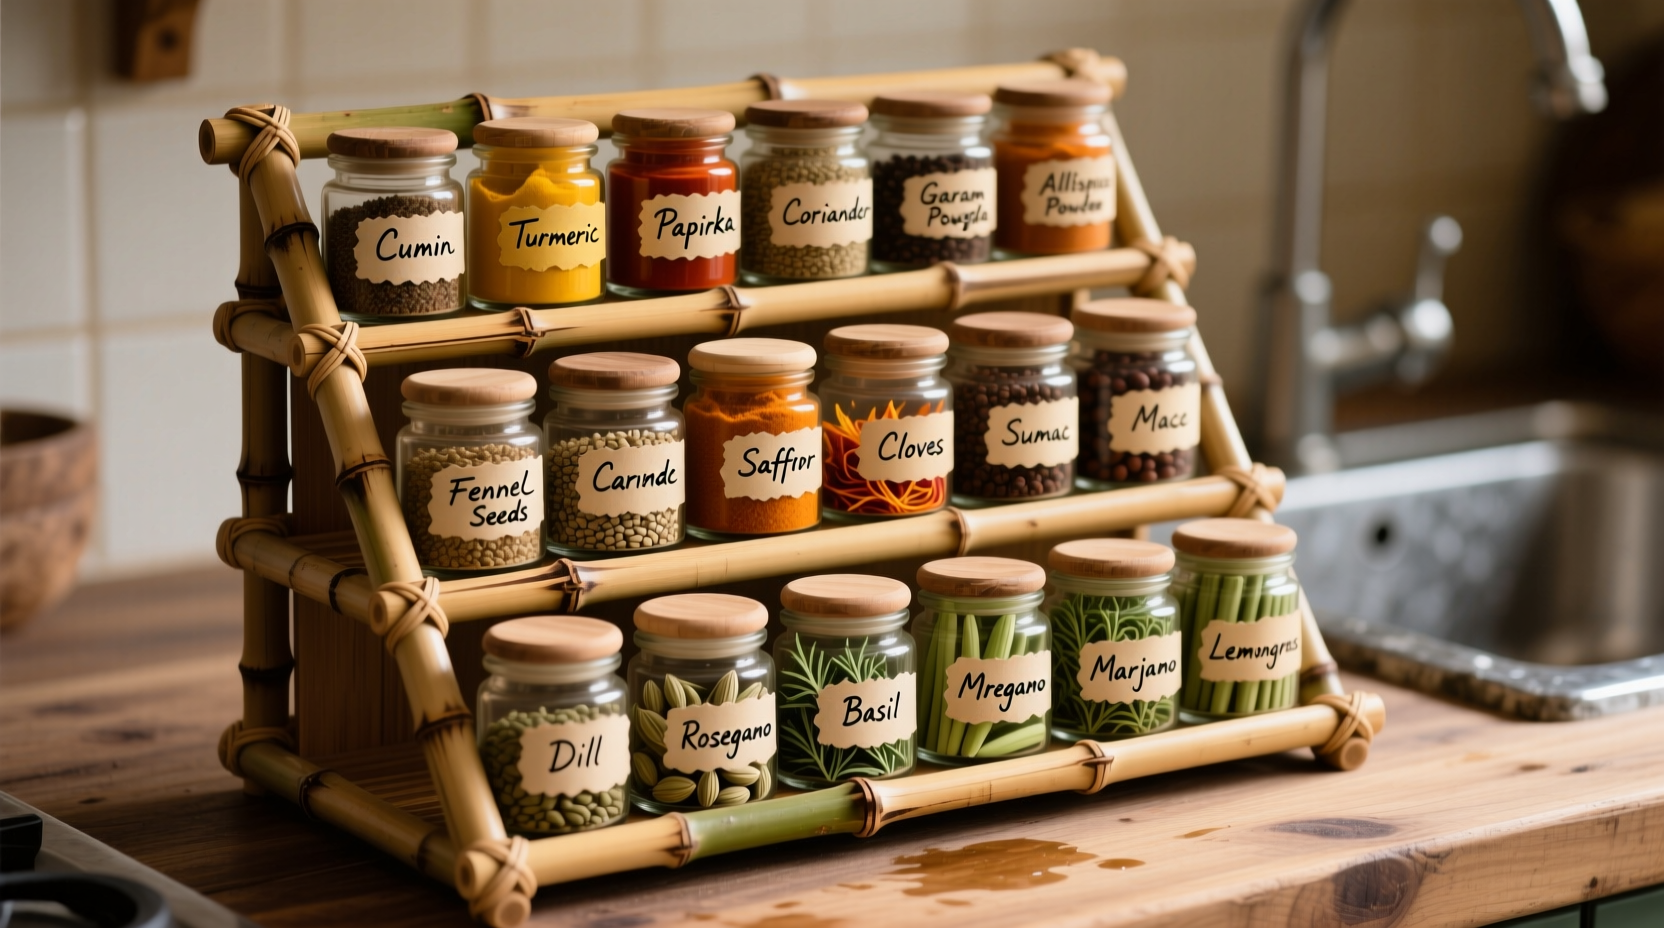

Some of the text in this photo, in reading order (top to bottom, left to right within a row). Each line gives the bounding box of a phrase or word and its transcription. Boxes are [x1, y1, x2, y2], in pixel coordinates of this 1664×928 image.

[921, 183, 985, 204] Garam
[376, 228, 455, 261] Cumin
[509, 219, 599, 248] Turmeric
[654, 208, 735, 248] Papirka
[878, 432, 944, 461] Cloves
[1002, 419, 1070, 446] Sumac
[450, 471, 534, 505] Fennel
[470, 499, 528, 527] Seeds
[1090, 655, 1176, 692] Marjano
[843, 691, 901, 726] Basil
[958, 672, 1046, 712] Mregano
[549, 736, 602, 772] Dill
[681, 721, 771, 759] Rosegano
